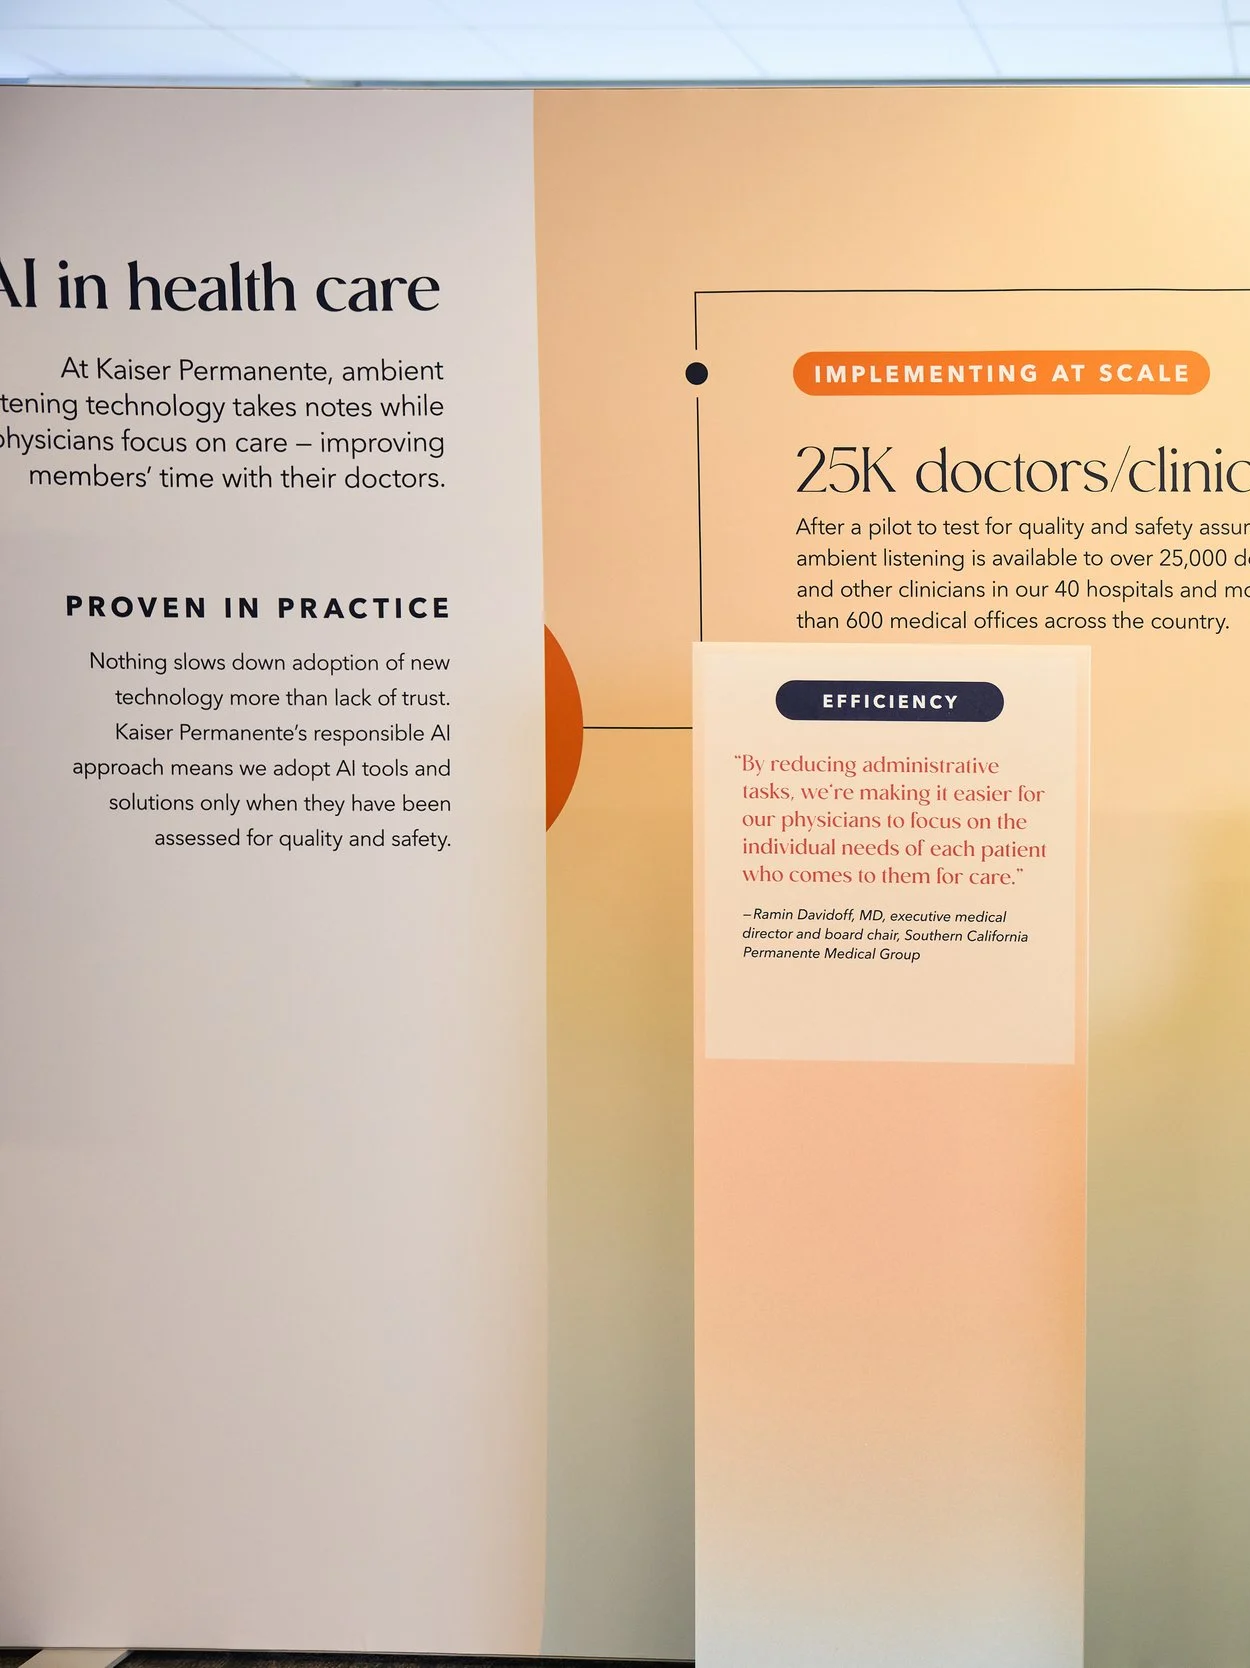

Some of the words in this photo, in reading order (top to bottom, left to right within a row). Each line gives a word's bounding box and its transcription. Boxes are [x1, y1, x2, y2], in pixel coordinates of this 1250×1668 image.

[59, 260, 108, 309] in
[128, 260, 296, 311] health
[316, 277, 439, 312] care
[61, 357, 88, 378] At
[97, 358, 171, 380] Kaiser
[180, 359, 332, 384] Permanente,
[343, 358, 443, 381] ambient
[815, 364, 1036, 383] IMPLEMENTING
[1052, 365, 1085, 381] AT
[1100, 364, 1188, 382] SCALE
[86, 393, 225, 423] technology
[233, 394, 296, 416] takes
[306, 399, 372, 417] notes
[380, 394, 443, 416] while
[0, 426, 113, 455] hysicians
[121, 429, 187, 452] focus
[196, 438, 225, 452] on
[236, 438, 287, 452] care
[321, 432, 443, 459] improving
[160, 467, 213, 488] time
[222, 466, 271, 488] with
[280, 466, 336, 488] their
[345, 466, 444, 488] doctors.
[797, 446, 896, 493] 25K
[796, 517, 844, 535] After
[851, 523, 861, 535] a
[870, 517, 912, 540] pilot
[917, 521, 936, 535] to
[943, 521, 979, 535] test
[985, 517, 1012, 534] for
[1019, 517, 1084, 539] quality
[1091, 517, 1127, 534] and
[1136, 517, 1192, 540] safety
[797, 548, 877, 566] ambient
[884, 548, 964, 571] listening
[973, 550, 985, 566] is
[993, 548, 1077, 566] available
[1083, 552, 1103, 566] to
[1111, 554, 1153, 566] over
[1160, 549, 1226, 569] 25,000
[67, 596, 204, 618] PROVEN
[225, 598, 257, 618] IN
[279, 597, 448, 619] PRACTICE
[797, 611, 838, 628] than
[847, 611, 882, 628] 600
[891, 611, 966, 629] medical
[974, 610, 1037, 628] offices
[1045, 617, 1106, 628] across
[1113, 611, 1144, 629] the
[1152, 615, 1229, 634] country.
[91, 652, 166, 675] Nothing
[174, 652, 225, 670] slows
[232, 653, 285, 670] down
[293, 653, 378, 675] adoption
[386, 653, 405, 670] of
[412, 659, 450, 670] new
[115, 687, 223, 710] technology
[231, 694, 279, 705] more
[286, 688, 327, 706] than
[336, 688, 371, 706] lack
[378, 688, 397, 706] of
[402, 692, 449, 705] trust.
[823, 694, 957, 709] EFFICIENCY
[116, 723, 173, 740] Kaiser
[315, 724, 424, 746] responsible
[431, 724, 449, 741] AI
[771, 755, 856, 777] reducing
[863, 756, 999, 773] administrative
[744, 783, 794, 800] tasks,
[860, 784, 930, 806] making
[937, 785, 946, 800] it
[954, 786, 1012, 801] easier
[1019, 785, 1045, 802] for
[743, 815, 775, 826] our
[782, 811, 881, 832] physicians
[888, 815, 904, 828] to
[911, 812, 961, 828] focus
[967, 818, 990, 829] on
[998, 813, 1026, 829] the
[155, 828, 239, 845] assessed
[247, 828, 273, 846] for
[280, 829, 342, 851] quality
[350, 829, 384, 846] and
[392, 829, 450, 851] safety.
[744, 838, 835, 855] individual
[842, 839, 899, 856] needs
[906, 839, 925, 856] of
[931, 840, 974, 856] each
[982, 841, 1045, 862] patient
[743, 865, 783, 882] who
[789, 871, 852, 883] comes
[859, 870, 875, 883] to
[882, 867, 930, 883] them
[937, 867, 963, 884] for
[798, 909, 854, 922] Davidoff,
[860, 910, 885, 922] MD,
[890, 912, 951, 922] executive
[955, 911, 1007, 922] medical
[743, 927, 793, 939] director
[796, 928, 821, 939] and
[825, 928, 863, 940] board
[867, 929, 899, 942] chair,
[905, 929, 962, 941] Southern
[967, 930, 1028, 942] California
[744, 947, 820, 958] Permanente
[825, 947, 876, 959] Medical
[880, 948, 920, 963] Group
